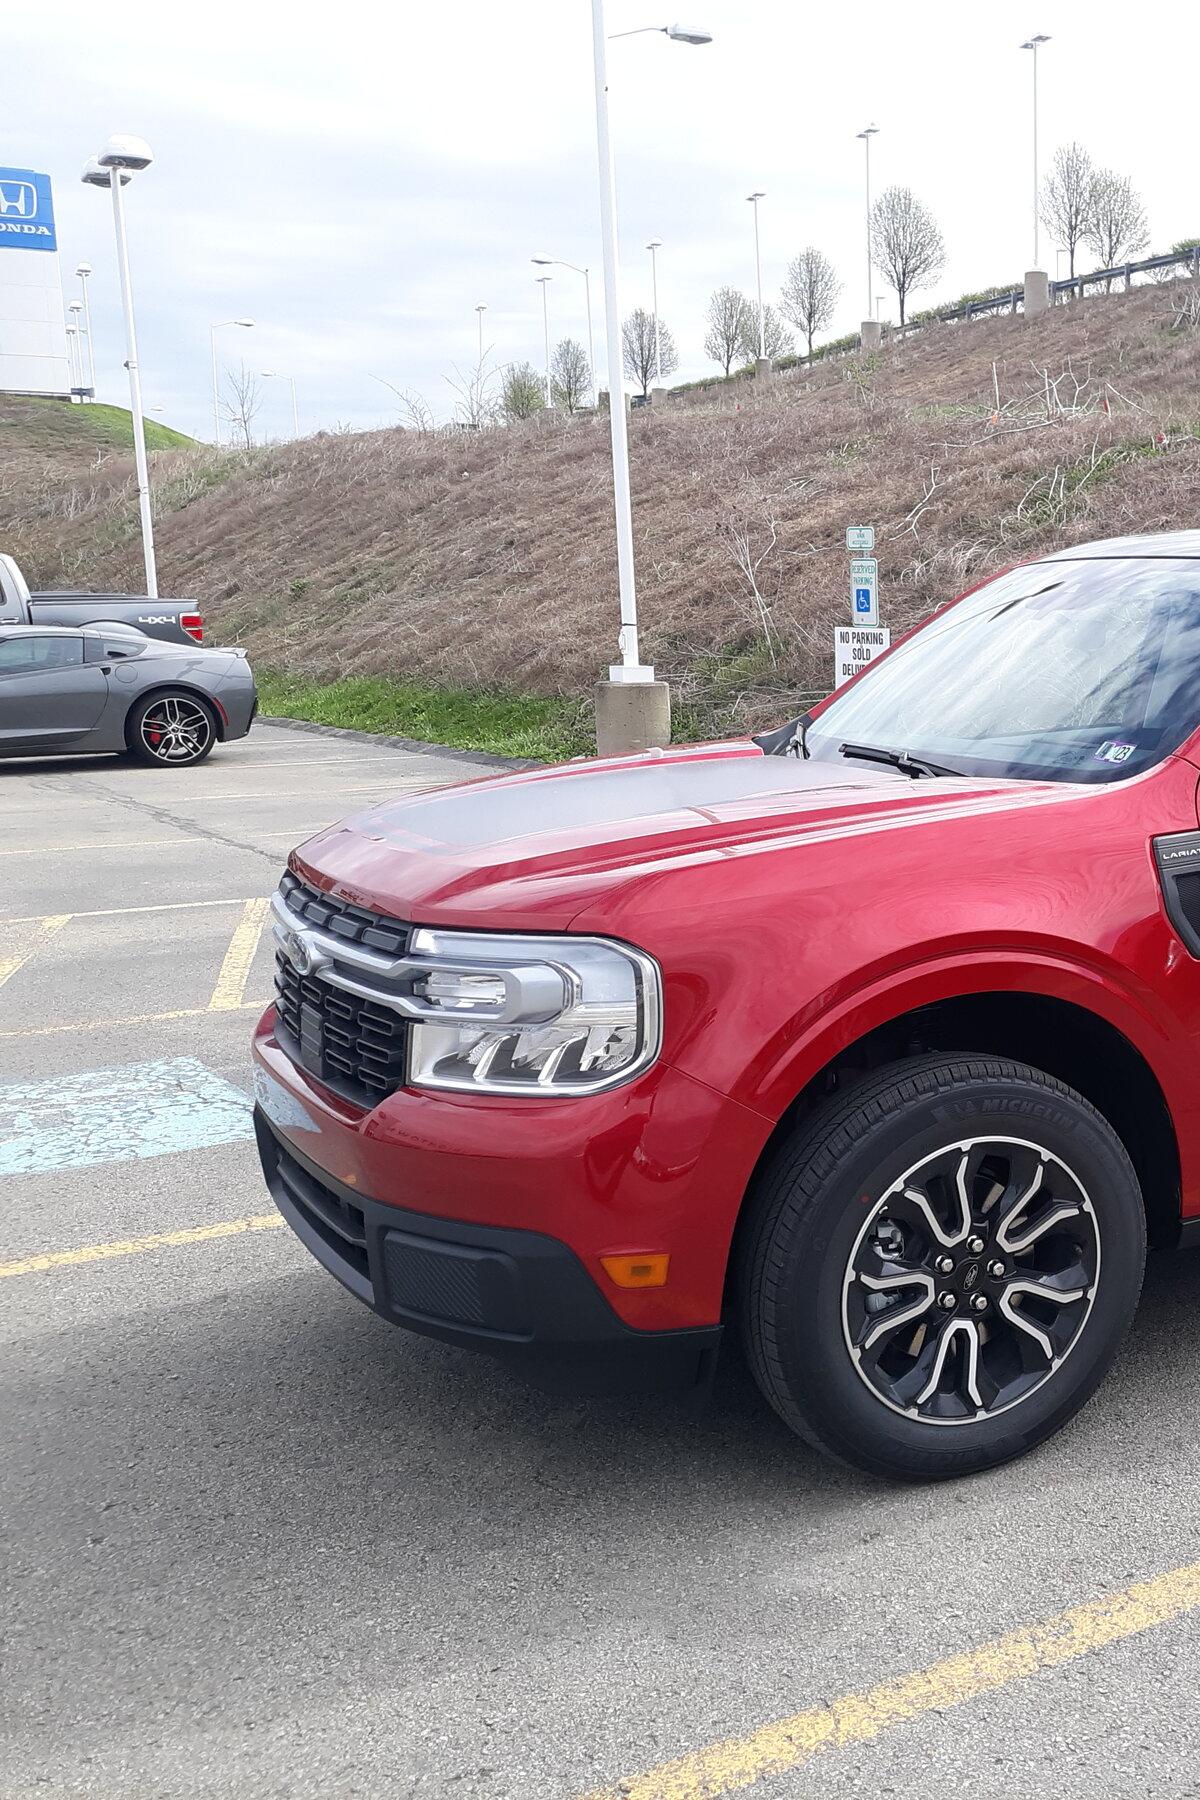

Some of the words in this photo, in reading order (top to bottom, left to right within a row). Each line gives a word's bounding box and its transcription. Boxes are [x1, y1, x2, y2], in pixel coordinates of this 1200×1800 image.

[0, 223, 51, 236] ONDA
[851, 565, 876, 574] RESERVED
[840, 632, 850, 643] NO
[852, 632, 884, 645] PARKING
[852, 648, 871, 660] SOLD
[842, 663, 866, 676] DELIV
[982, 1099, 1076, 1128] MICHELIN
